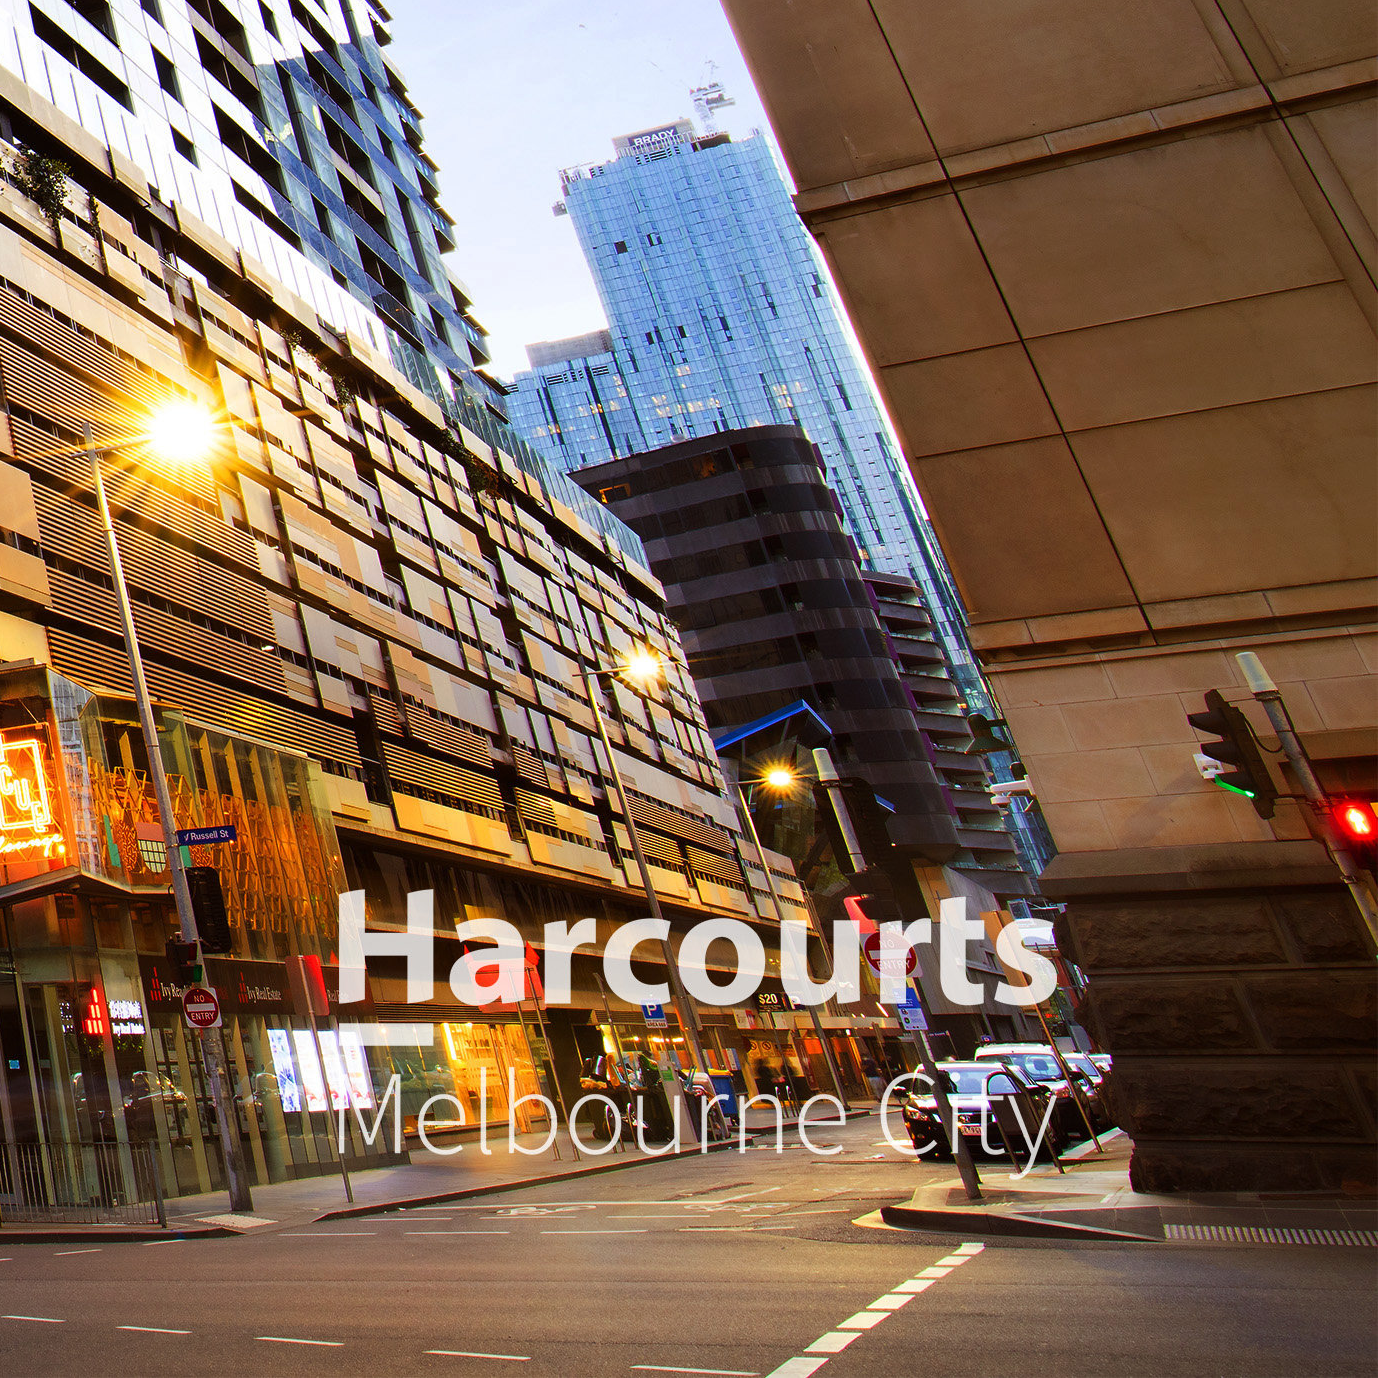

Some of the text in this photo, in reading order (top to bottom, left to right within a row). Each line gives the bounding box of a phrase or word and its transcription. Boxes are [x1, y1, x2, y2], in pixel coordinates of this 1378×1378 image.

[634, 129, 675, 146] BRADY
[190, 829, 229, 841] Russell St
[879, 940, 895, 949] NO
[877, 959, 911, 970] ENTRY
[194, 994, 205, 1003] NO
[247, 985, 282, 1003] Ivy Real Estate
[758, 993, 779, 1005] $20
[191, 1011, 215, 1021] ENTRY
[646, 1003, 658, 1017] P
